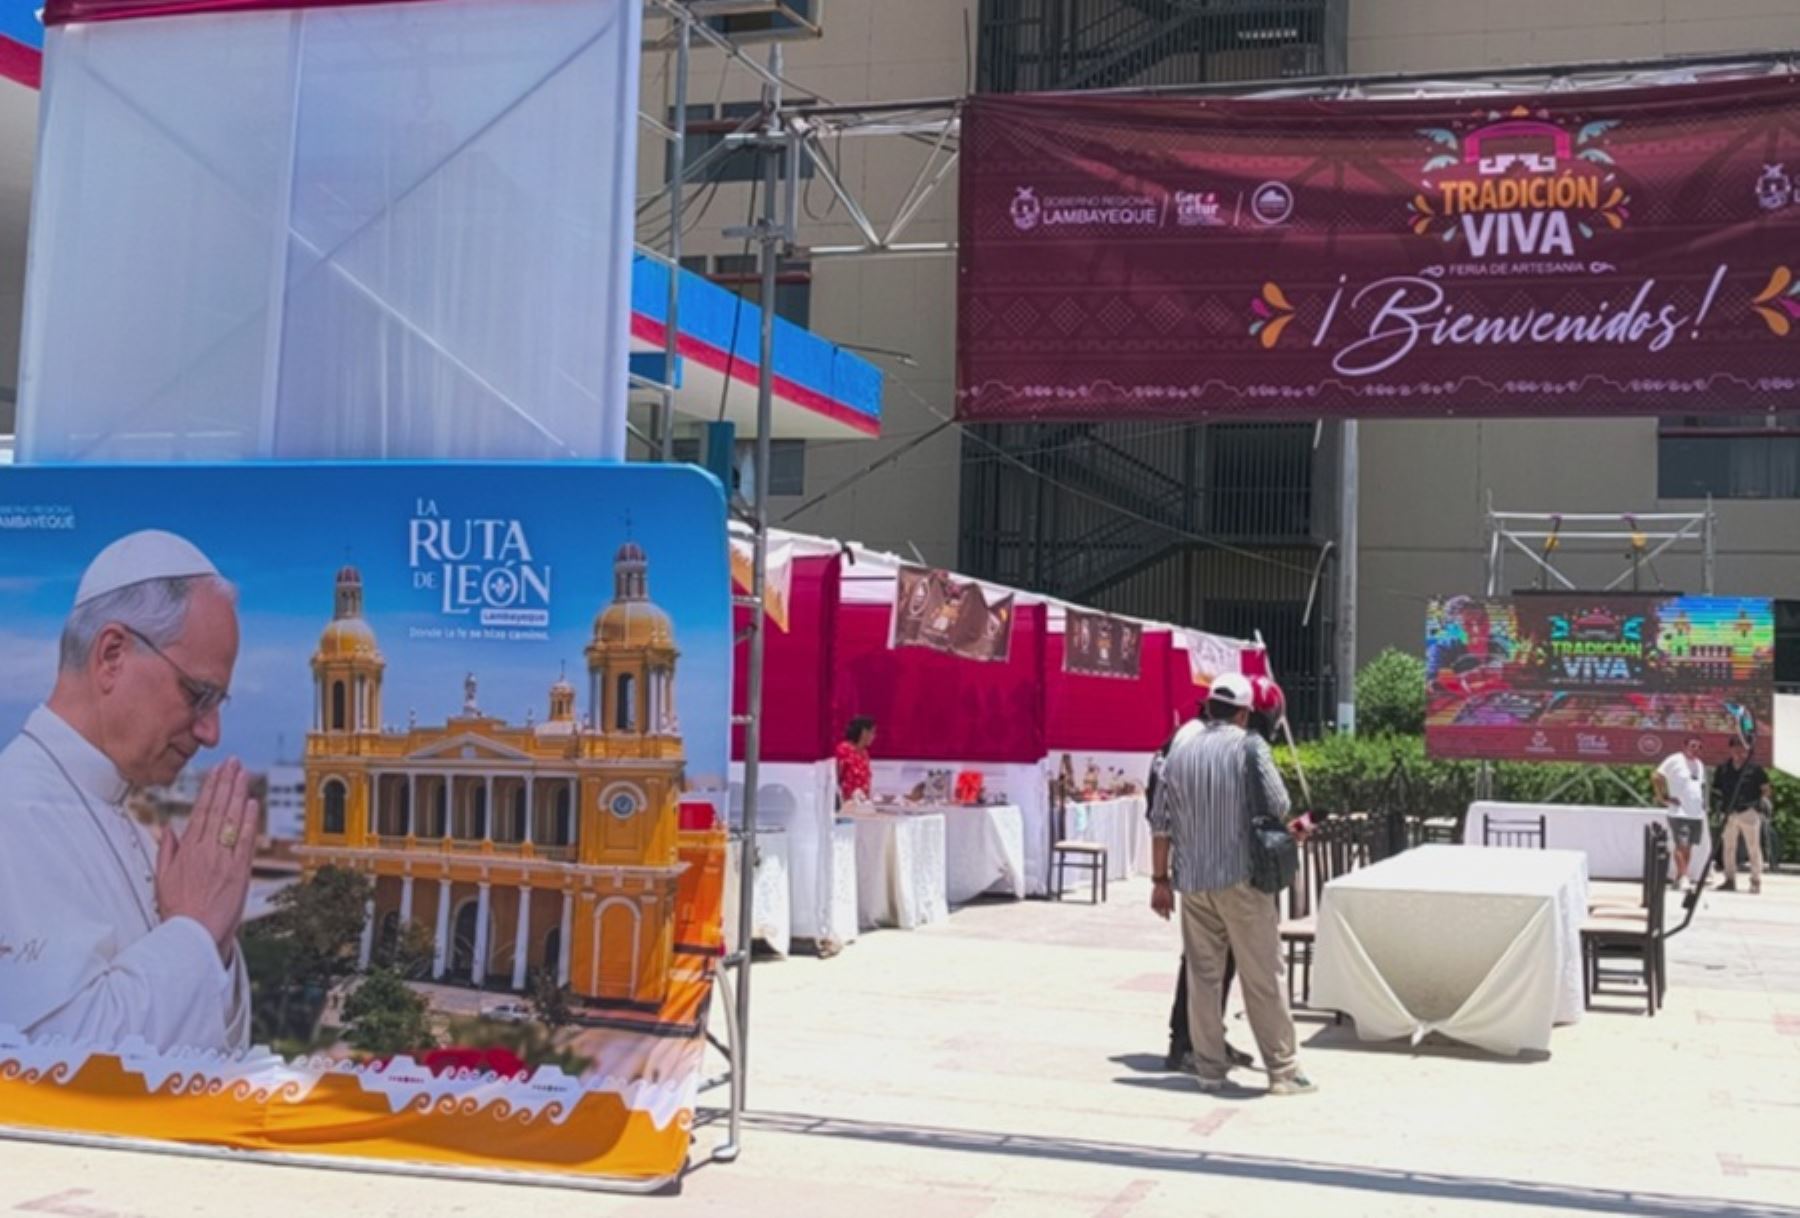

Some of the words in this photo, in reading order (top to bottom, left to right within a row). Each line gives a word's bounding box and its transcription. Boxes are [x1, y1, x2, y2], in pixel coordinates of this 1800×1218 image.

[1440, 170, 1598, 214] TRADICIÓN
[1042, 208, 1157, 225] LAMBAYEQUE
[1461, 211, 1575, 257] VIVA
[1450, 263, 1488, 275] FERIA
[1490, 263, 1507, 274] DE
[416, 497, 439, 516] LA
[409, 518, 532, 567] RUTA
[413, 571, 437, 588] DE
[442, 559, 550, 614] LEÓN
[1551, 640, 1642, 658] TRADICIÓN
[1561, 656, 1631, 678] VIVA
